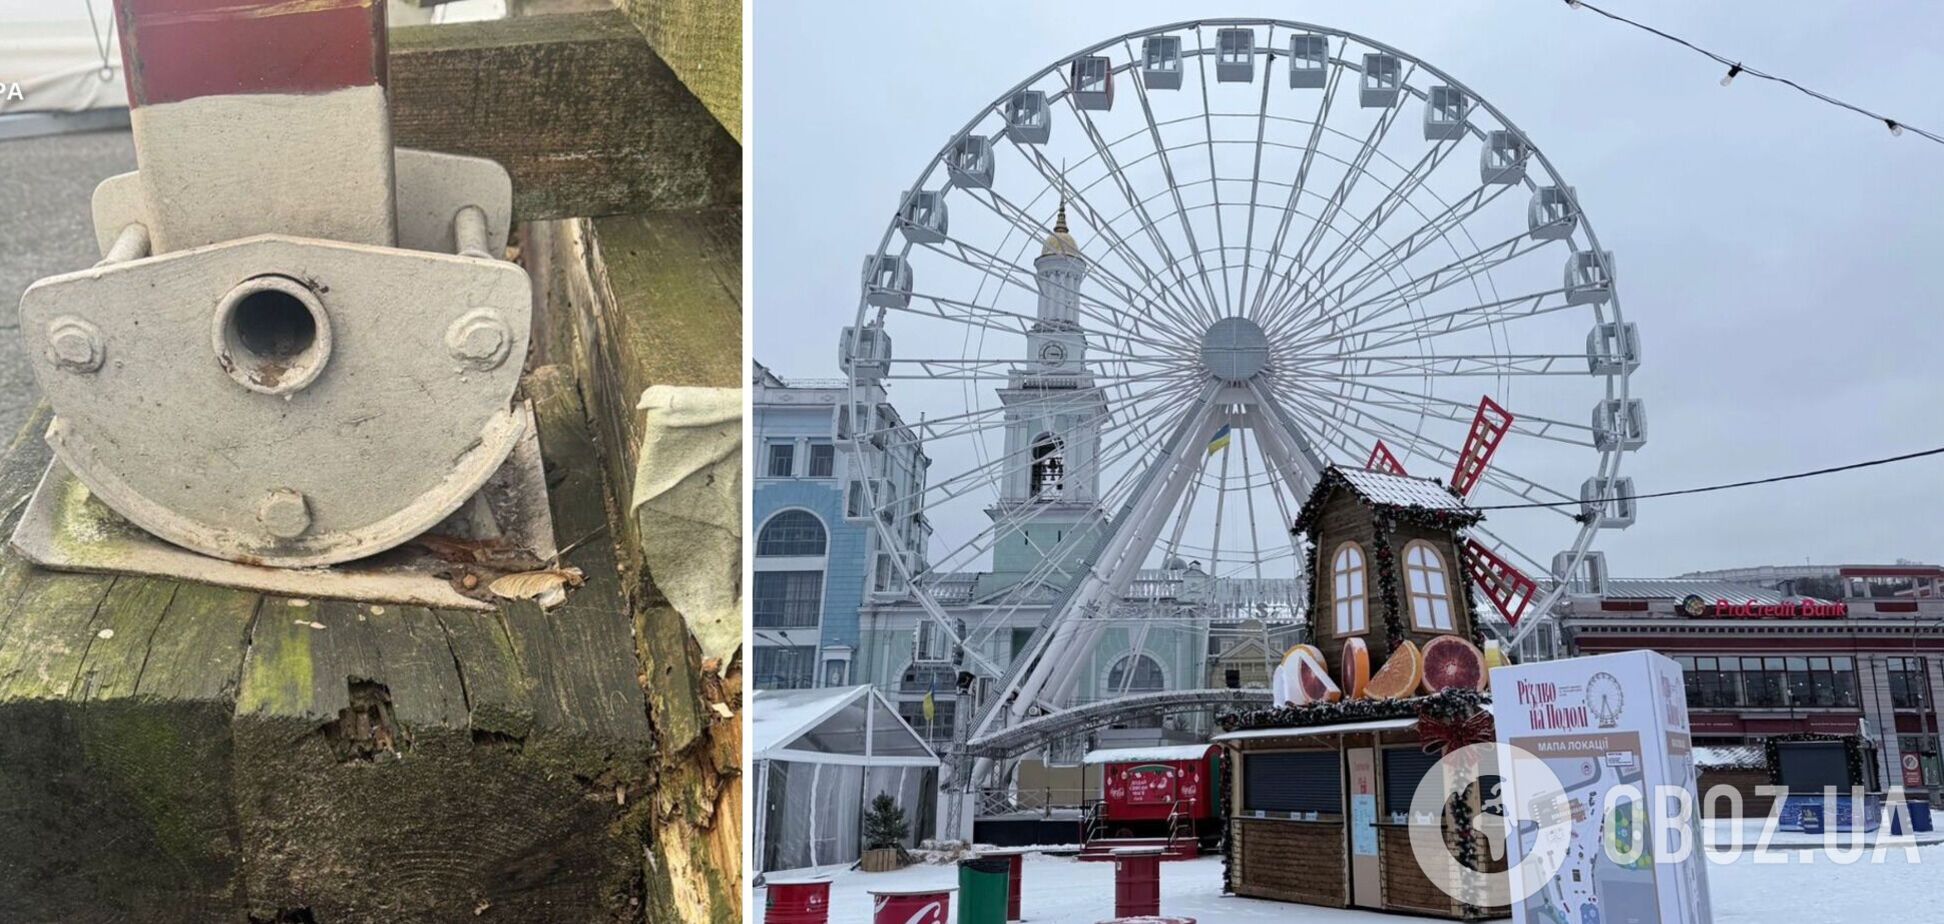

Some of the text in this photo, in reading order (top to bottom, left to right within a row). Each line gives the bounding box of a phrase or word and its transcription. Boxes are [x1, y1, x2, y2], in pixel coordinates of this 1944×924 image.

[1715, 598, 1847, 618] ProCredit Bank
[1517, 677, 1557, 708] Різдво
[1529, 699, 1589, 733] на Подолі
[1538, 737, 1609, 752] МАПА ЛОКАЦІЇ
